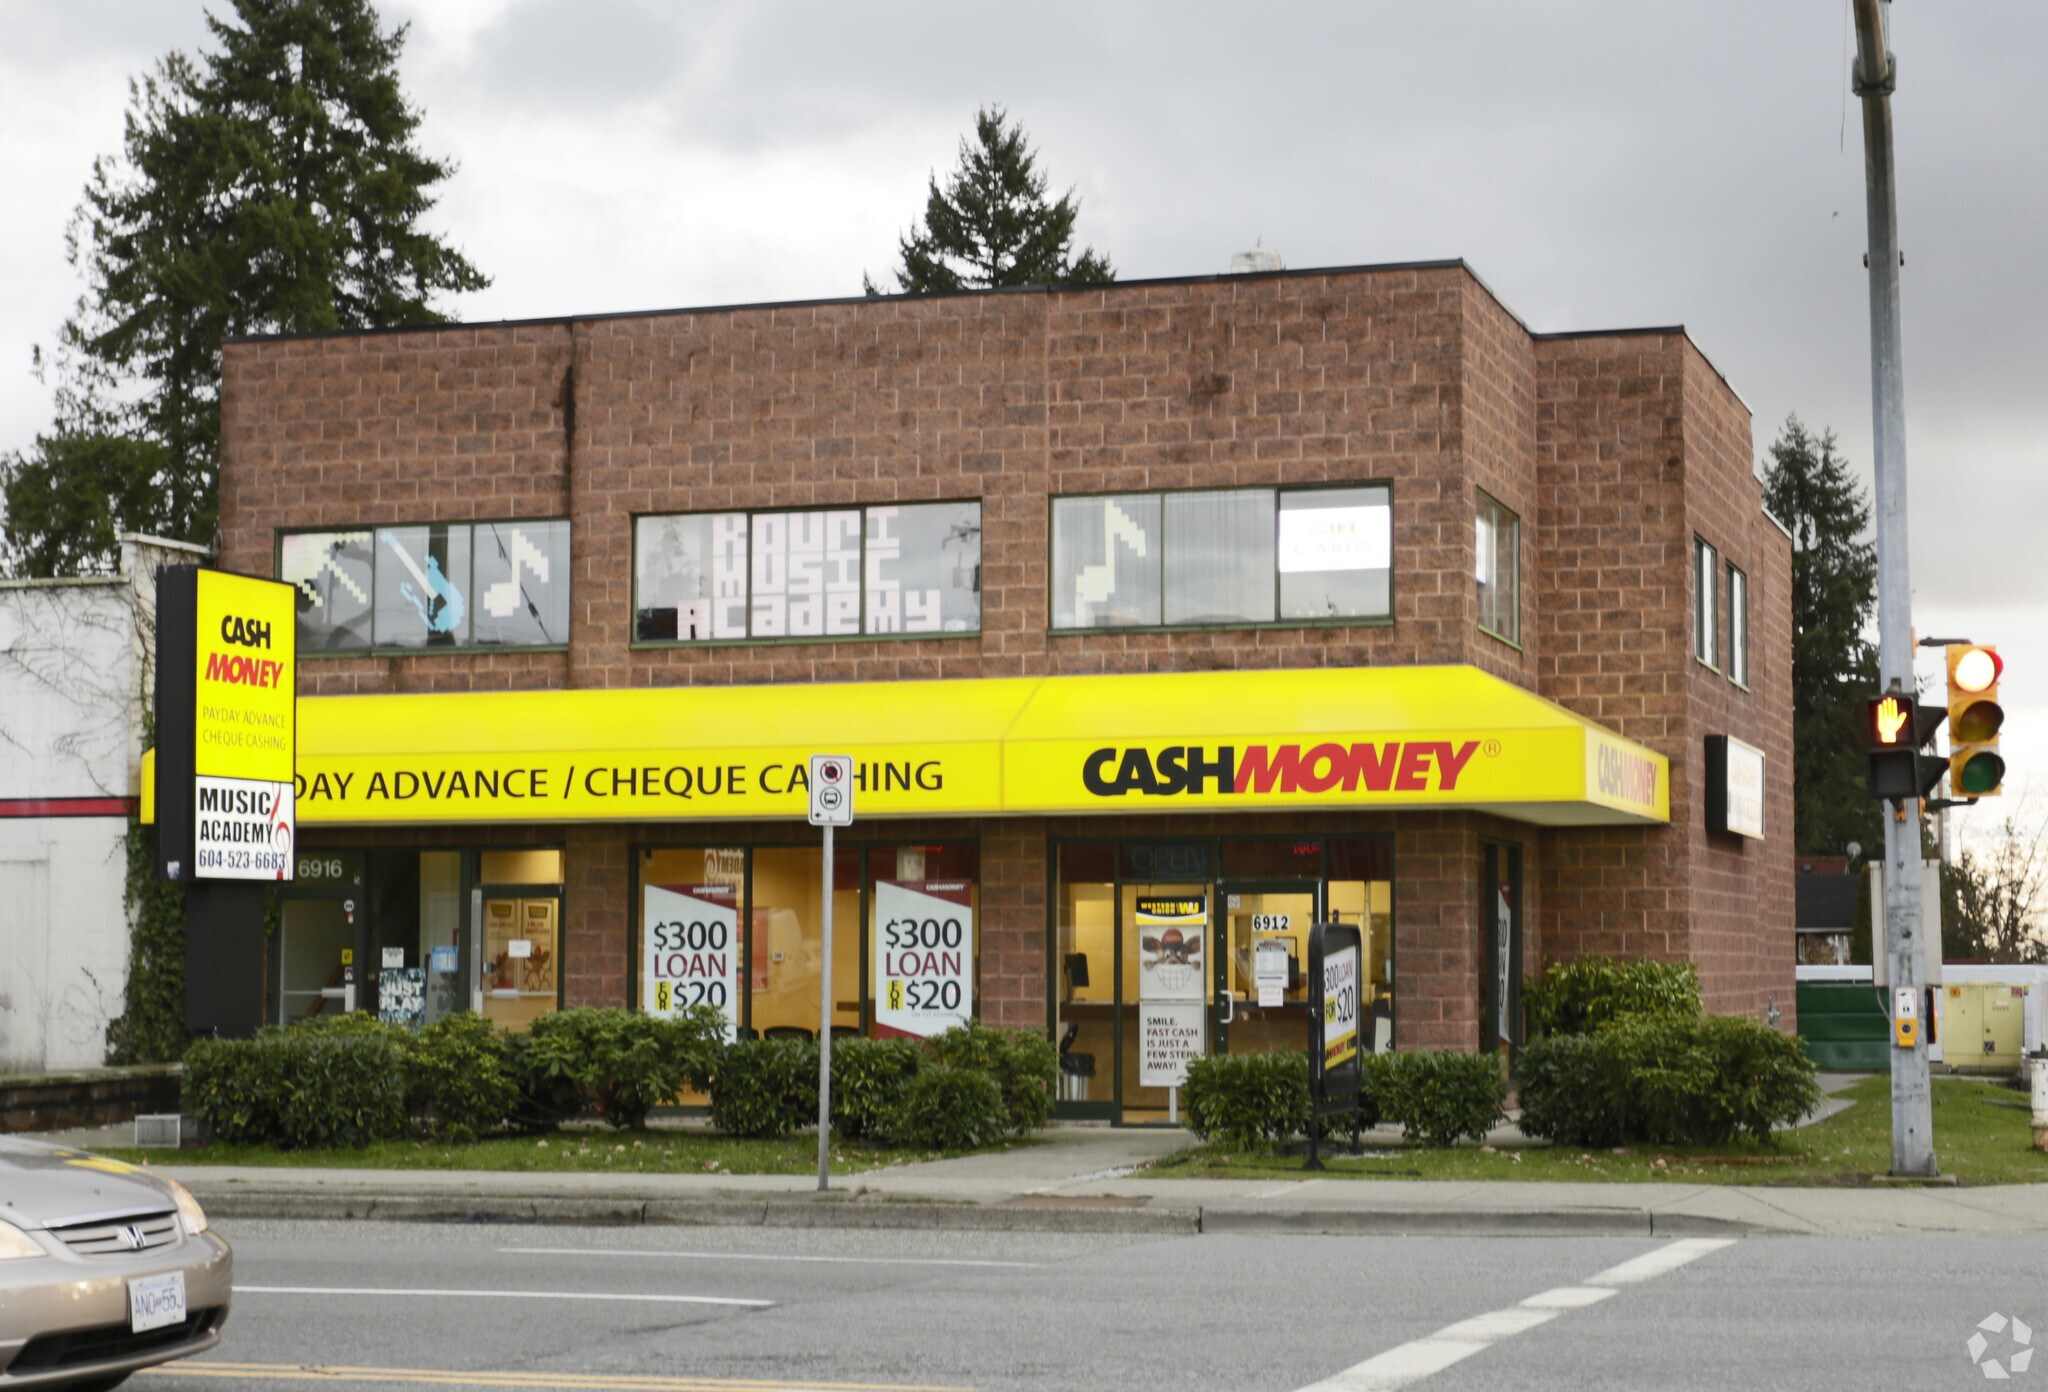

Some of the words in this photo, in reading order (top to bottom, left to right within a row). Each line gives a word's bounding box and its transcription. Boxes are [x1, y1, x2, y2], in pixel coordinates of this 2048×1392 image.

[221, 615, 271, 649] CASH
[205, 653, 283, 689] MONEY
[203, 706, 240, 724] PAYDAY
[243, 711, 286, 729] ADVANCE
[203, 729, 243, 747] CHEQUE
[246, 732, 286, 750] CASHING
[366, 768, 548, 800] ADVANCE
[584, 763, 746, 798] CHEQUE
[759, 761, 943, 793] CAHING
[200, 787, 271, 816] MUSIC
[200, 820, 273, 844] ACADEMY
[199, 849, 285, 870] 604-523-6683
[298, 860, 342, 877] 6916
[885, 918, 962, 949] $300
[1254, 915, 1288, 930] 6912
[654, 921, 728, 951] $300
[654, 953, 727, 978] LOAN
[886, 951, 961, 977] LOAN
[383, 982, 423, 996] JUST
[658, 981, 668, 1010] FOR
[674, 981, 727, 1012] $20
[889, 980, 900, 1010] FOR
[906, 980, 962, 1010] $20
[381, 996, 422, 1010] PLAY
[1326, 1001, 1335, 1019] FOR
[1338, 985, 1354, 1024] $20
[1147, 1017, 1178, 1026] SMILE.
[1147, 1028, 1169, 1037] FAST
[1172, 1028, 1198, 1037] CASH
[1147, 1039, 1155, 1048] IS
[1158, 1039, 1180, 1048] JUST
[1183, 1039, 1189, 1048] A
[1147, 1050, 1167, 1059] FEW
[1147, 1061, 1177, 1071] AWAY!
